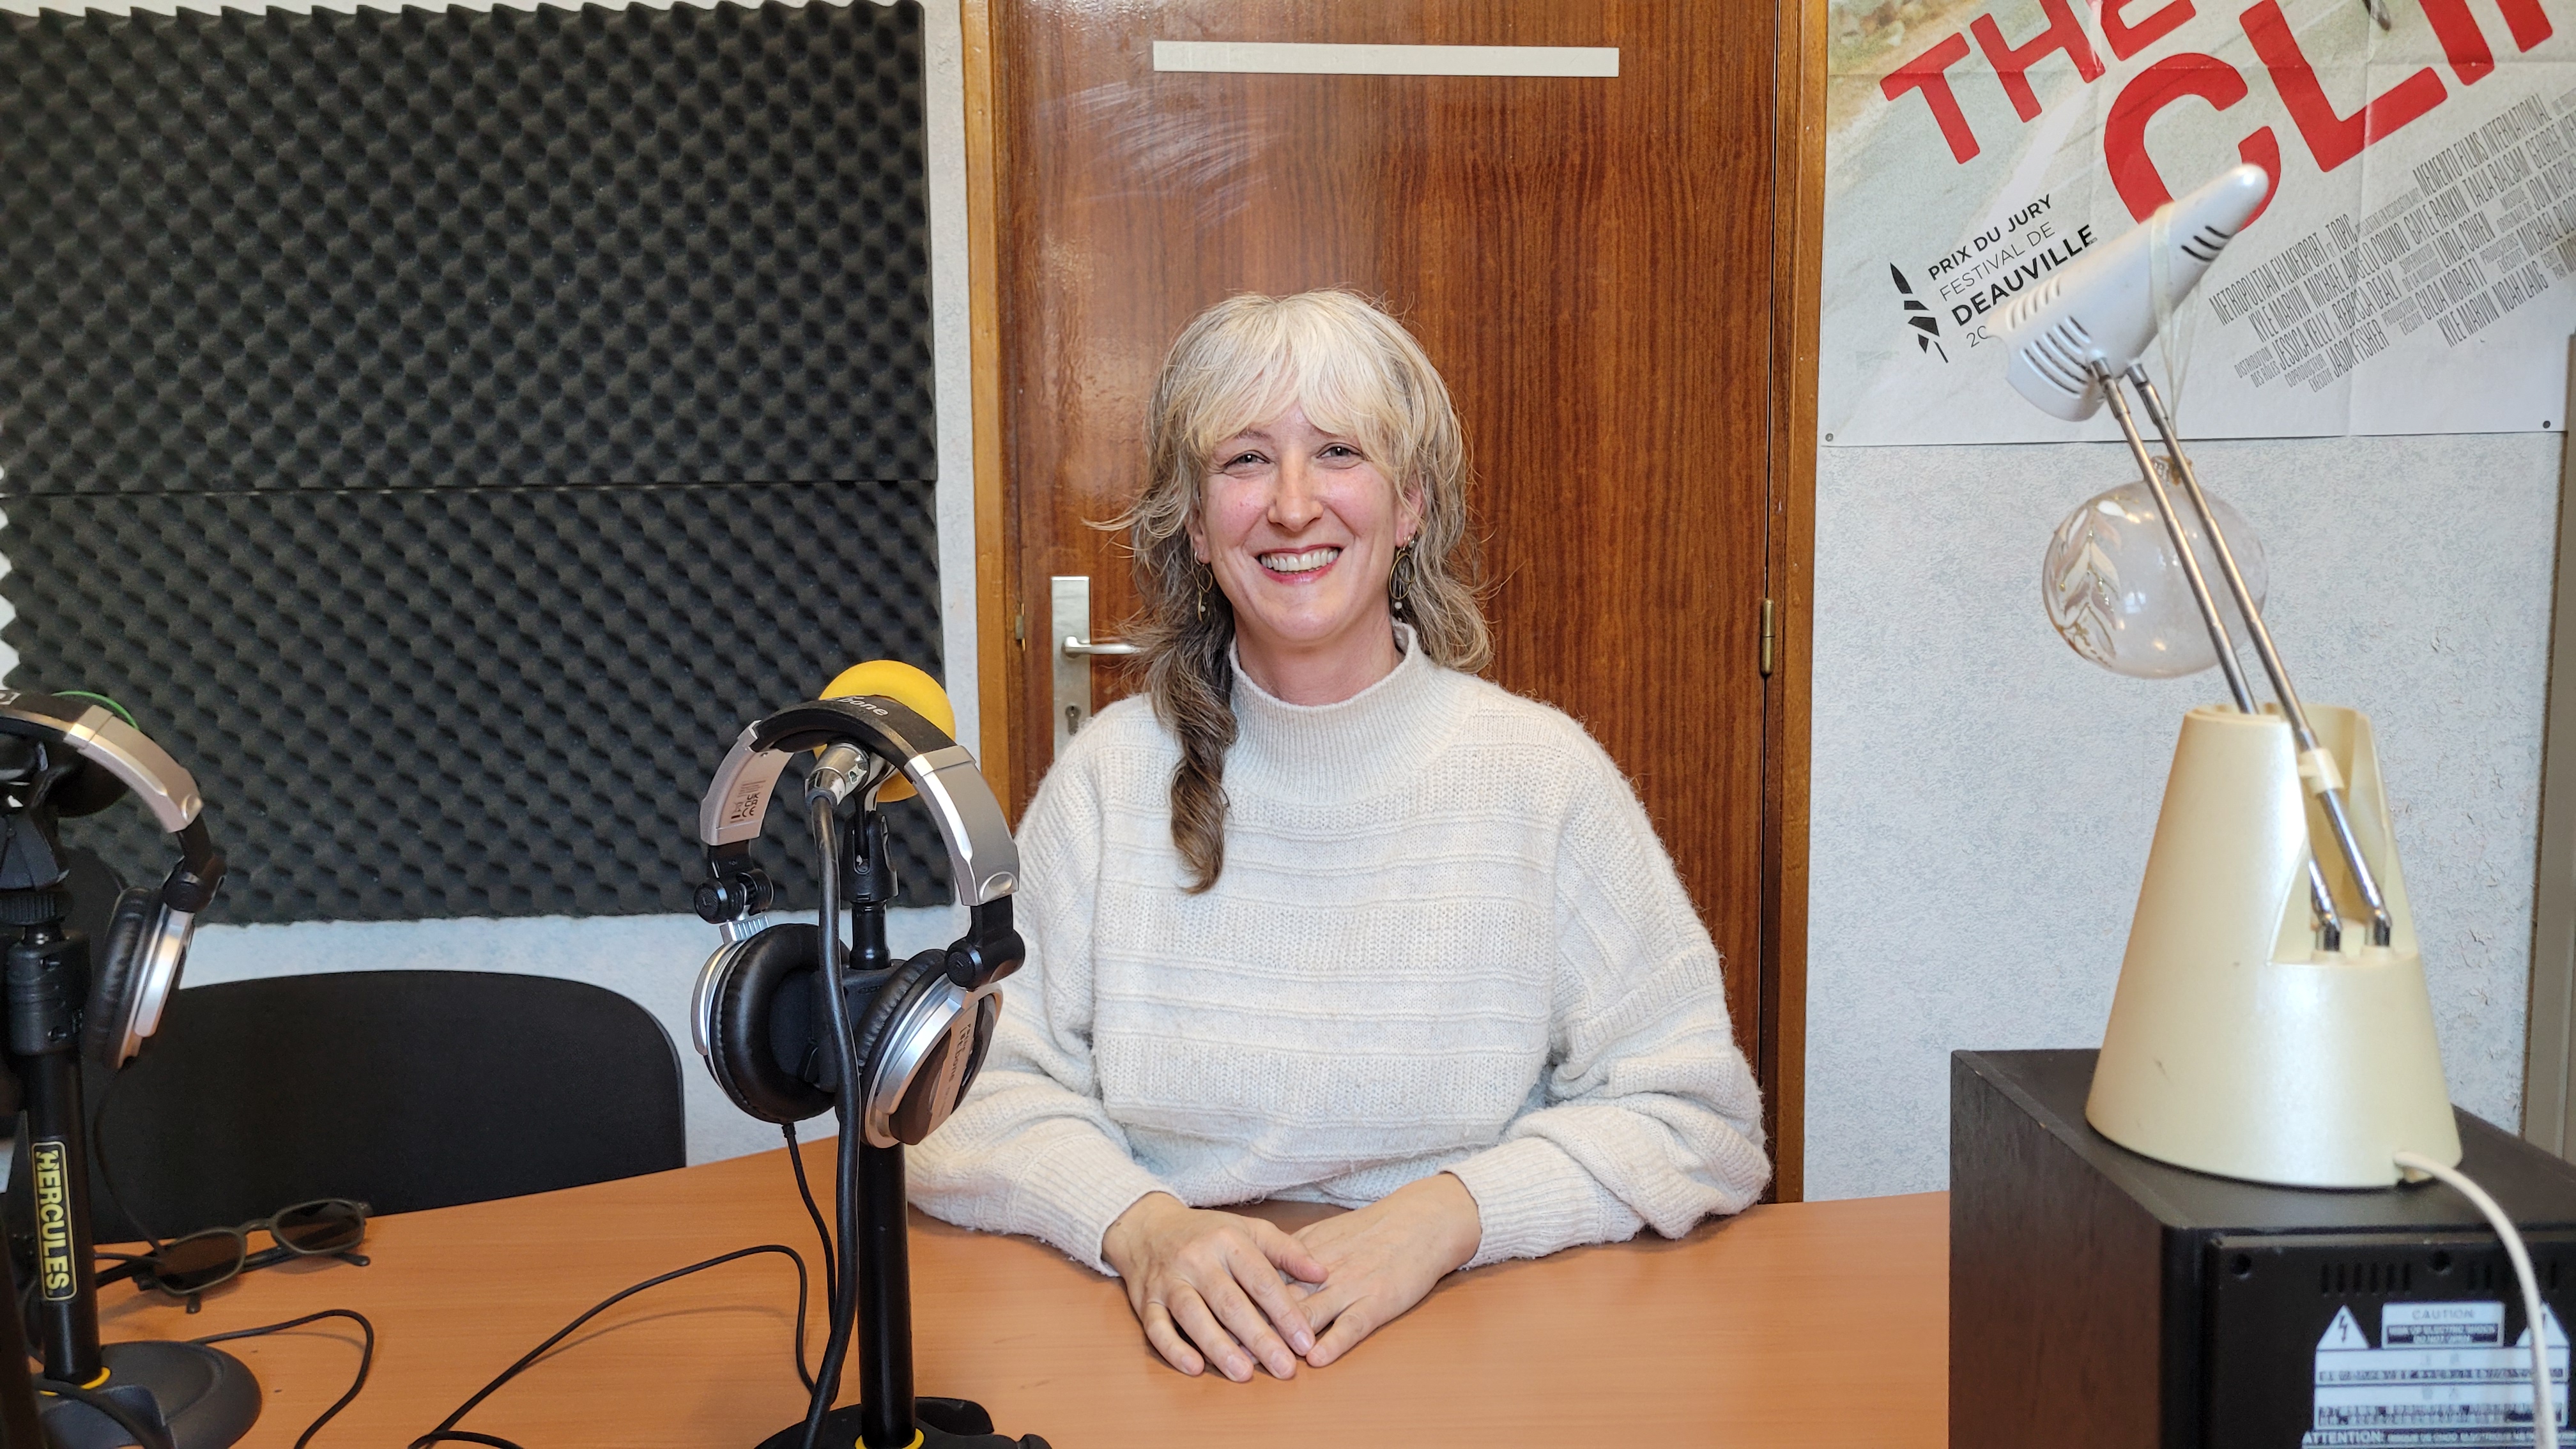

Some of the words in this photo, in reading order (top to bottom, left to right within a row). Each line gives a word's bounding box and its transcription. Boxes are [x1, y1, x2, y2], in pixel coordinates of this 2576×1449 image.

[1880, 0, 2196, 164] THE
[2208, 263, 2281, 326] METROPOLITAN
[2269, 232, 2329, 288] FILMEXPORT
[2325, 213, 2359, 252] TOPIC
[2412, 147, 2463, 197] MEMENTO
[2453, 131, 2489, 172] FILMS
[2479, 93, 2552, 157] INTERNATIONAL
[2499, 186, 2527, 211] MUSIQUE
[2524, 174, 2552, 211] JON
[2248, 305, 2279, 342] KYLE
[2267, 285, 2312, 330] MARVIN
[2303, 261, 2349, 308] MICHAEL
[2338, 241, 2380, 286] ANGELO
[2370, 222, 2411, 266] COVINO
[2402, 204, 2439, 245] GAYLE
[2428, 185, 2470, 229] RANKIN
[2462, 168, 2497, 208] TALIA
[2487, 146, 2533, 192] BALSAM
[2524, 123, 2567, 169] GEORGE
[2496, 205, 2527, 233] ORIGINALE
[2523, 201, 2534, 216] DE
[2516, 211, 2563, 257] MICHAEL
[1928, 245, 1972, 280] PRIX
[1973, 227, 2001, 252] DU
[2008, 194, 2051, 233] JURY
[2432, 228, 2469, 268] LINDA
[2457, 210, 2496, 252] COHEN
[2480, 232, 2519, 265] PRODUCTEURS
[1939, 244, 2025, 302] FESTIVAL
[2027, 222, 2055, 247] DE
[1952, 224, 2096, 326] DEAUVILLE
[2399, 243, 2435, 274] SUPERVISEUR
[2402, 276, 2414, 292] DE
[2409, 272, 2421, 288] LA
[2417, 257, 2444, 282] MUSIQUE
[2552, 263, 2566, 280] PAR
[2415, 280, 2450, 320] GILDA
[2440, 257, 2487, 304] MORATTI
[2437, 310, 2466, 347] KYLE
[2456, 290, 2499, 335] MARVIN
[2492, 273, 2526, 313] NOAH
[2515, 259, 2549, 298] LANG
[2271, 326, 2313, 370] JESSICA
[2303, 310, 2336, 350] KELLY
[2331, 285, 2377, 332] REBECCA
[2366, 268, 2402, 309] DEALY
[2382, 296, 2417, 326] PRODUCTEUR
[2400, 310, 2425, 335] EXÉCUTIF
[2234, 346, 2273, 378] DISTRIBUTION
[2325, 336, 2359, 378] JASON
[2349, 318, 2389, 360] FISHER
[2250, 370, 2264, 387] DES
[2284, 353, 2327, 387] COPRODUCTEUR
[2308, 367, 2334, 392] EXÉCUTIF
[36, 1150, 70, 1290] HERCULES
[2412, 1309, 2474, 1320] CAUTION
